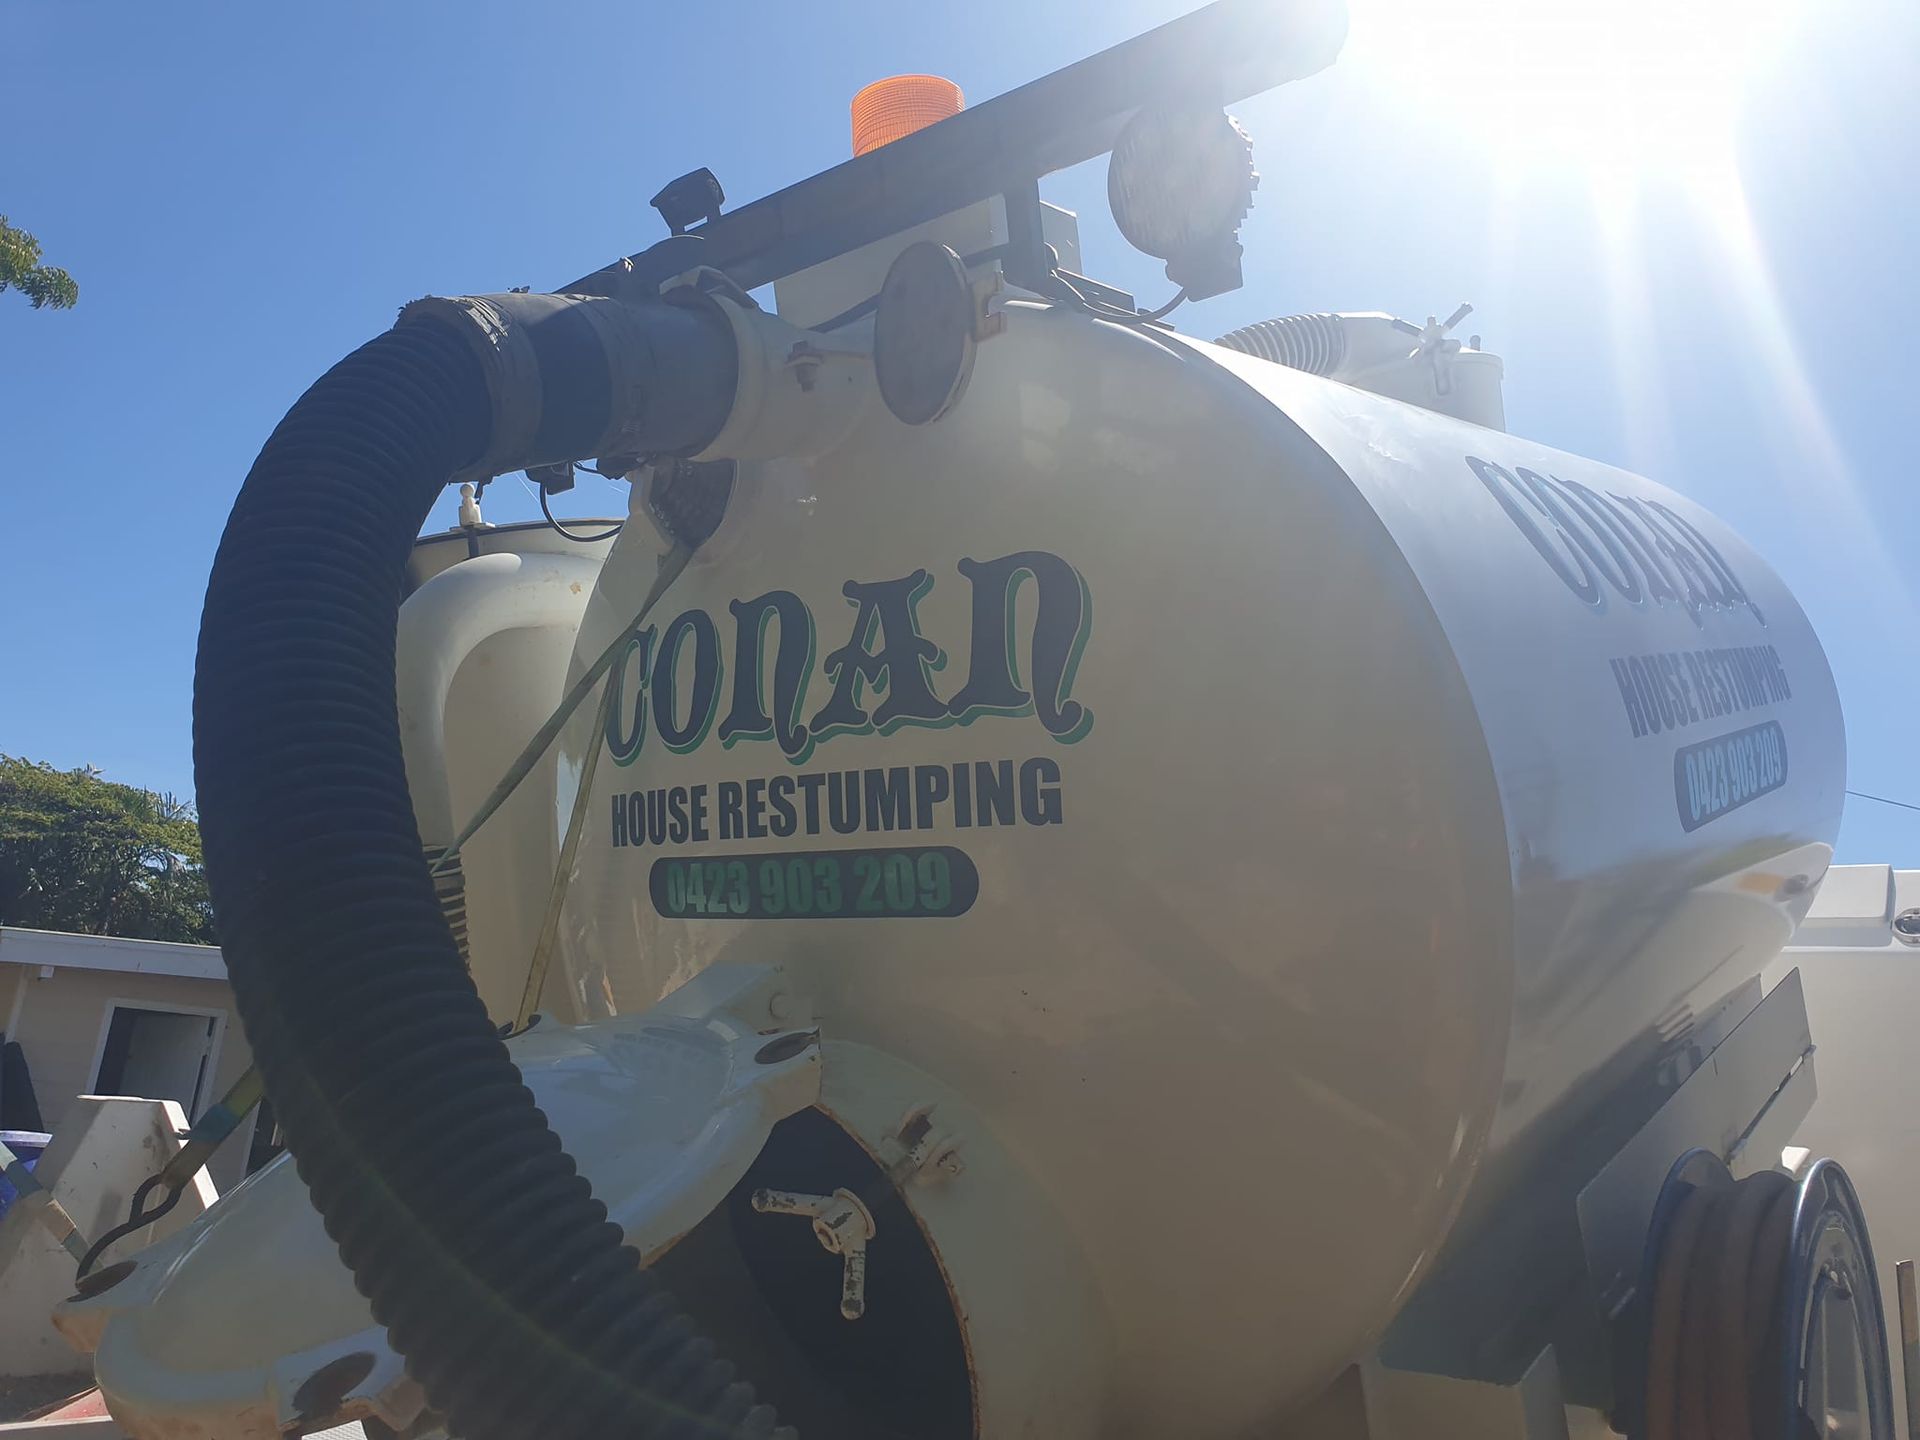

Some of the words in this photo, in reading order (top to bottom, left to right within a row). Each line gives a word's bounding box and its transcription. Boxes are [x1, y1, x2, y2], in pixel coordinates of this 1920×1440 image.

[604, 550, 1095, 768] CONAN
[1608, 652, 1700, 739] HOUSE
[1682, 644, 1793, 721] RESTUMPING
[611, 784, 709, 848] HOUSE
[717, 757, 1064, 842] RESTUMPING
[1685, 744, 1729, 822] 0423
[1727, 736, 1759, 802] 903
[1755, 726, 1783, 789] 209
[666, 859, 751, 915] 0423
[758, 855, 843, 914] 903
[852, 850, 953, 911] 209
